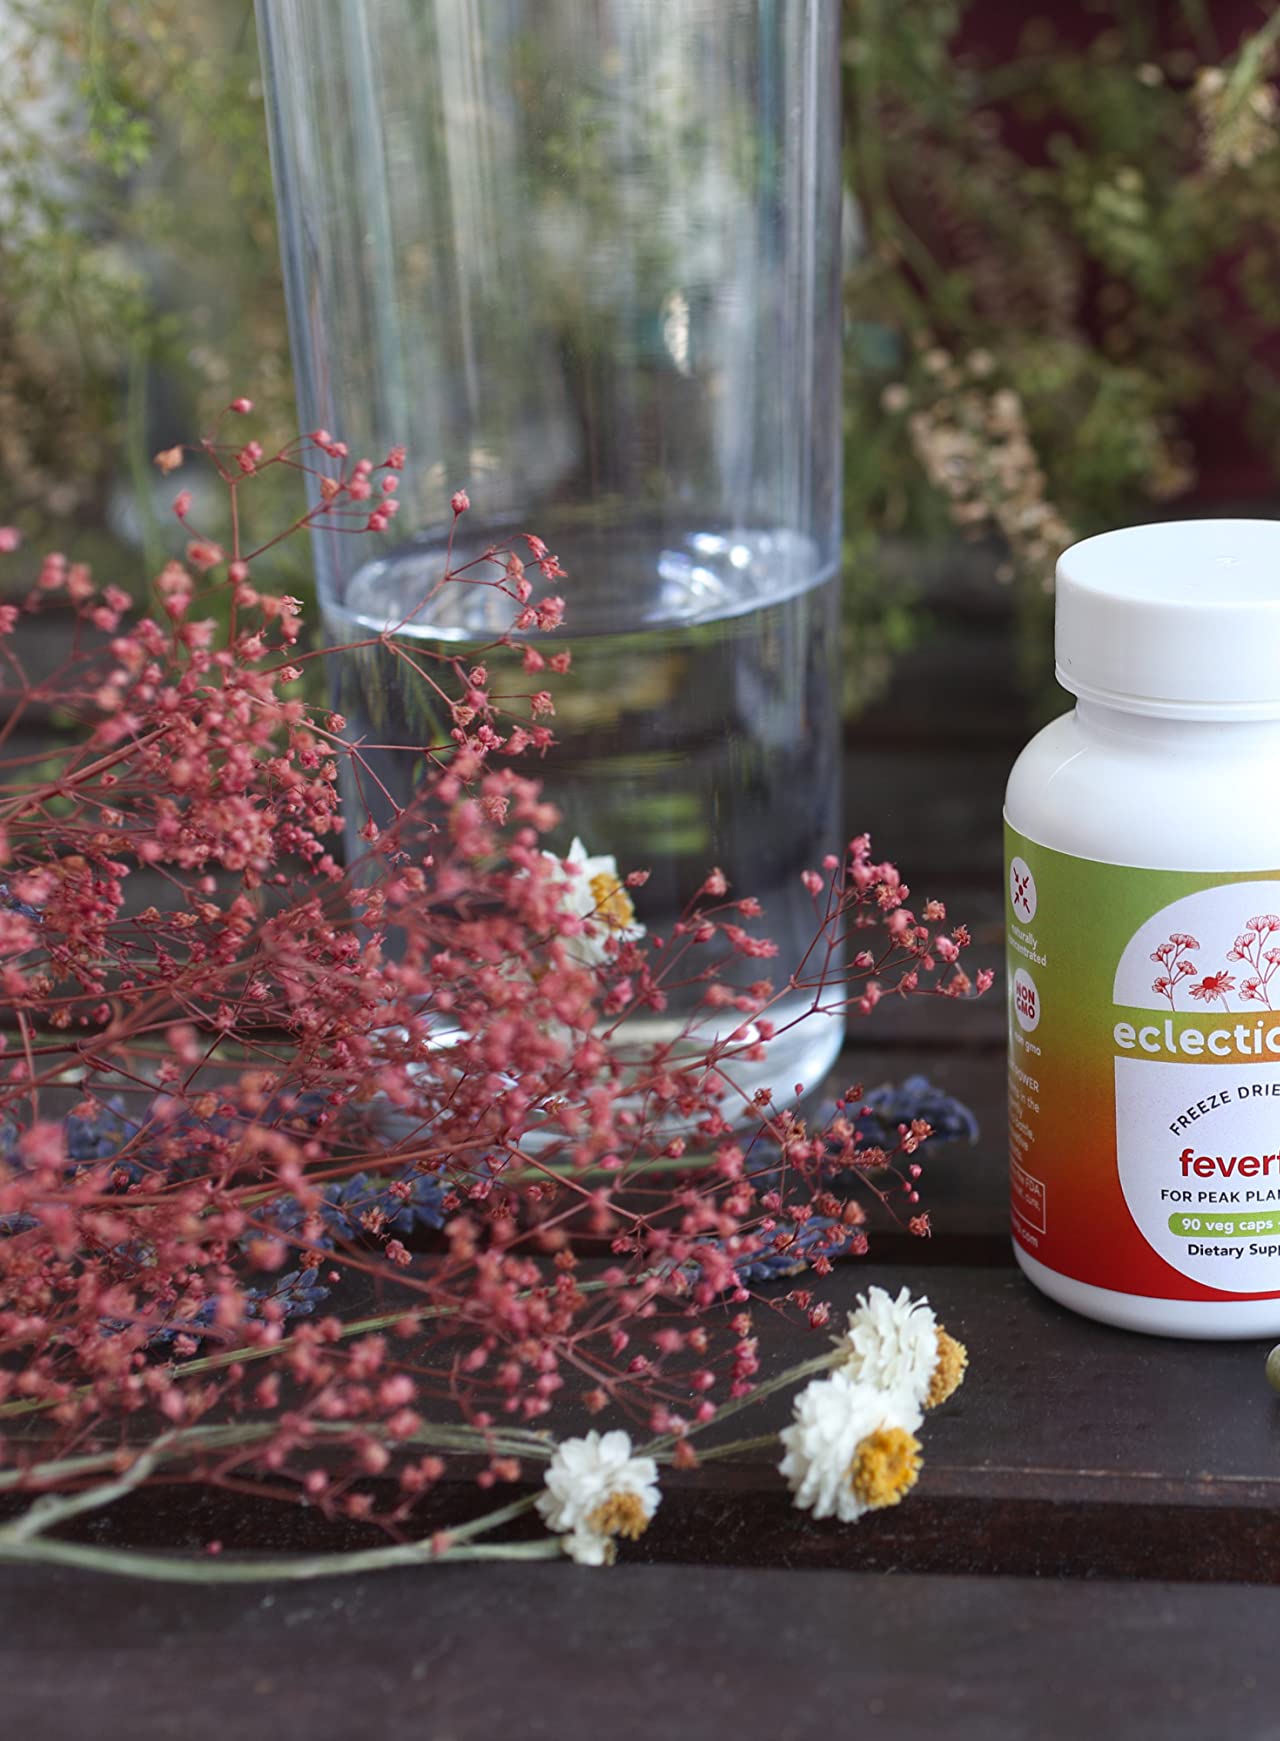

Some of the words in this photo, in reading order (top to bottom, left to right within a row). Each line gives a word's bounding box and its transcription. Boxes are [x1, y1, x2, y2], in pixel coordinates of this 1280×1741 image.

[1016, 981, 1036, 1006] NON
[1016, 996, 1036, 1020] GMO
[1168, 1090, 1232, 1137] FREEZE
[1161, 1189, 1192, 1202] FOR
[1198, 1191, 1241, 1204] PEAK
[1181, 1217, 1201, 1231] 90
[1205, 1221, 1235, 1235] veg
[1239, 1219, 1273, 1233] caps
[1187, 1243, 1245, 1259] Dietary
